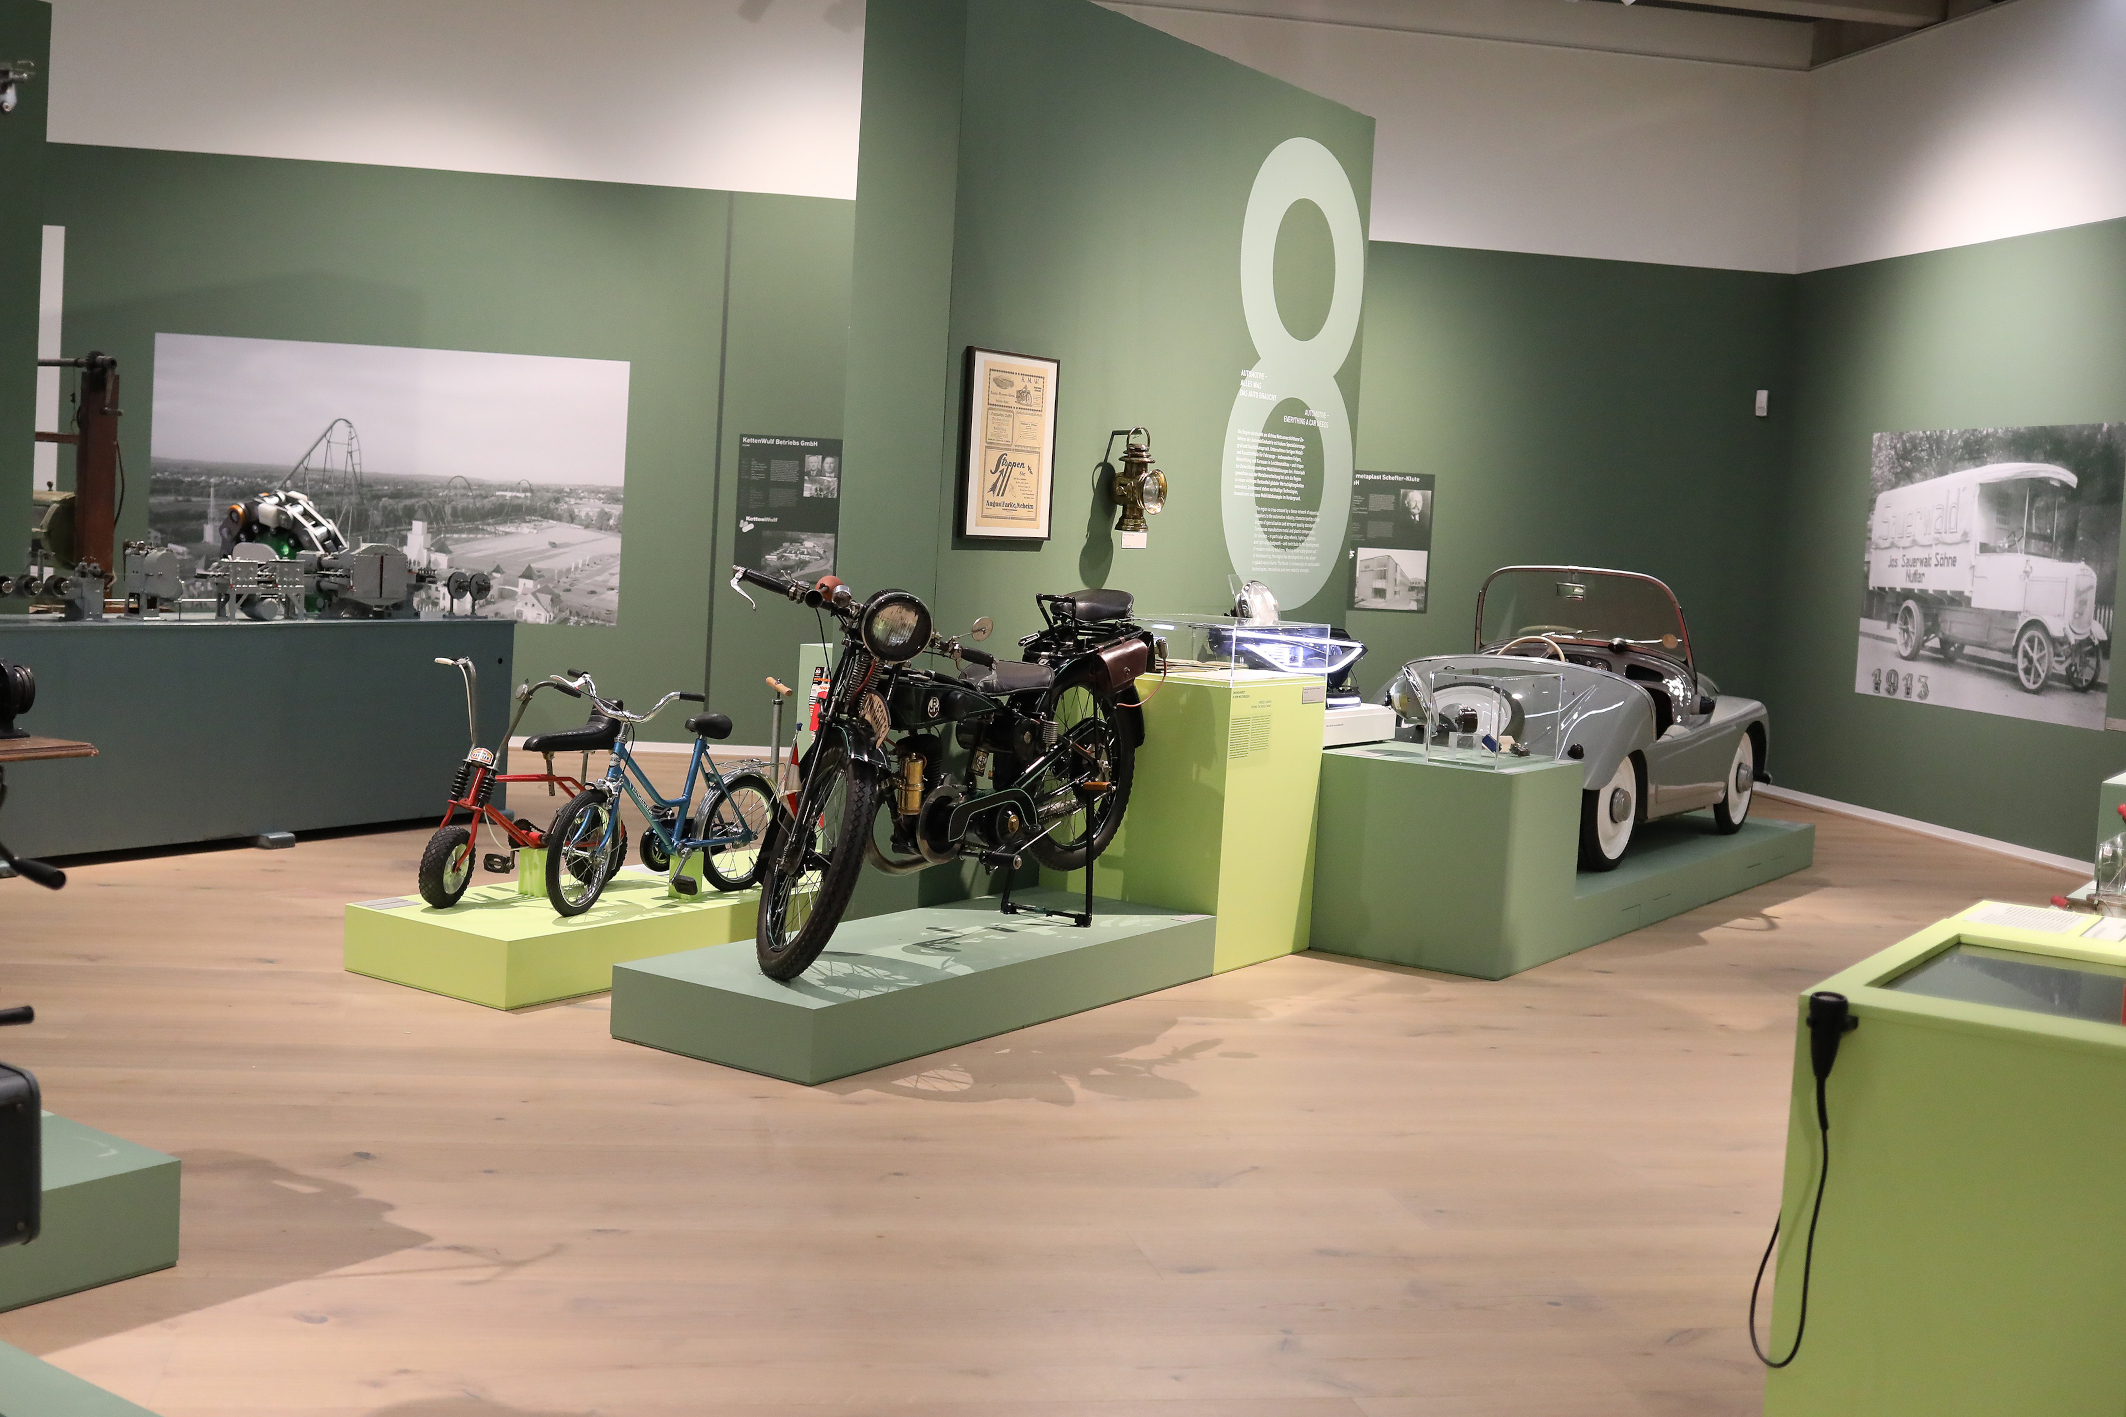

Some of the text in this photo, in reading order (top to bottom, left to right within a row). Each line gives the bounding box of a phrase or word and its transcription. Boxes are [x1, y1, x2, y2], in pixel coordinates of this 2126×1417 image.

[742, 437, 774, 445] KettenWulf
[1382, 474, 1420, 483] Scheffer-Klute
[1934, 552, 1957, 568] Söhne
